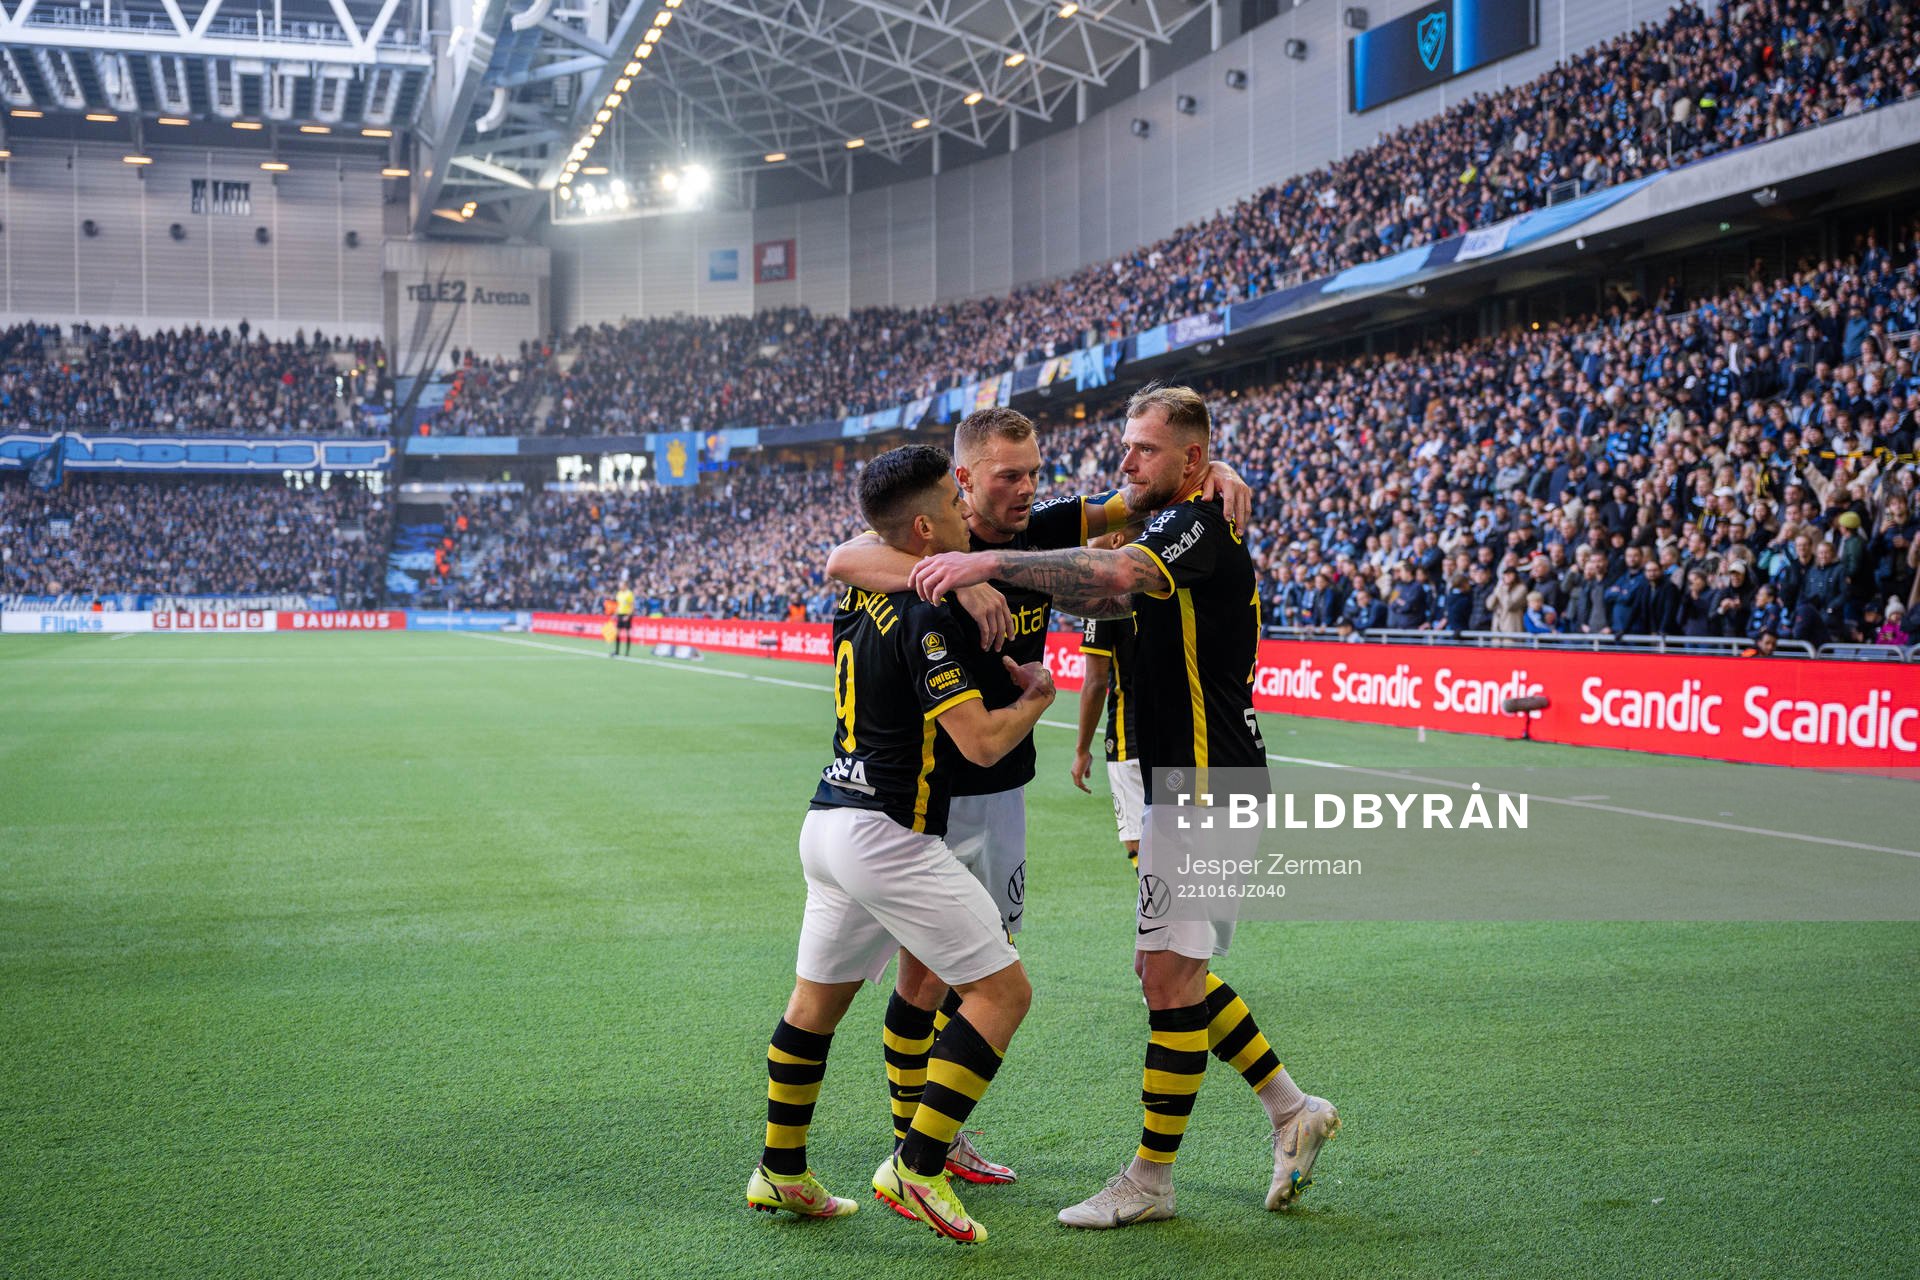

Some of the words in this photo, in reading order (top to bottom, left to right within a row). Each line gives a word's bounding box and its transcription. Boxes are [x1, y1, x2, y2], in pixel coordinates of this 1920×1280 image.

[406, 280, 467, 302] TELE2
[471, 287, 530, 305] Arena
[1161, 520, 1204, 563] stadium
[154, 612, 263, 628] CRAMO
[292, 613, 390, 628] BAUHAUS
[928, 668, 961, 688] UNIBET
[1253, 658, 1323, 700] candic
[1331, 662, 1423, 709] Scandic
[1580, 676, 1723, 735] Scandic
[1742, 685, 1919, 752] Scandic
